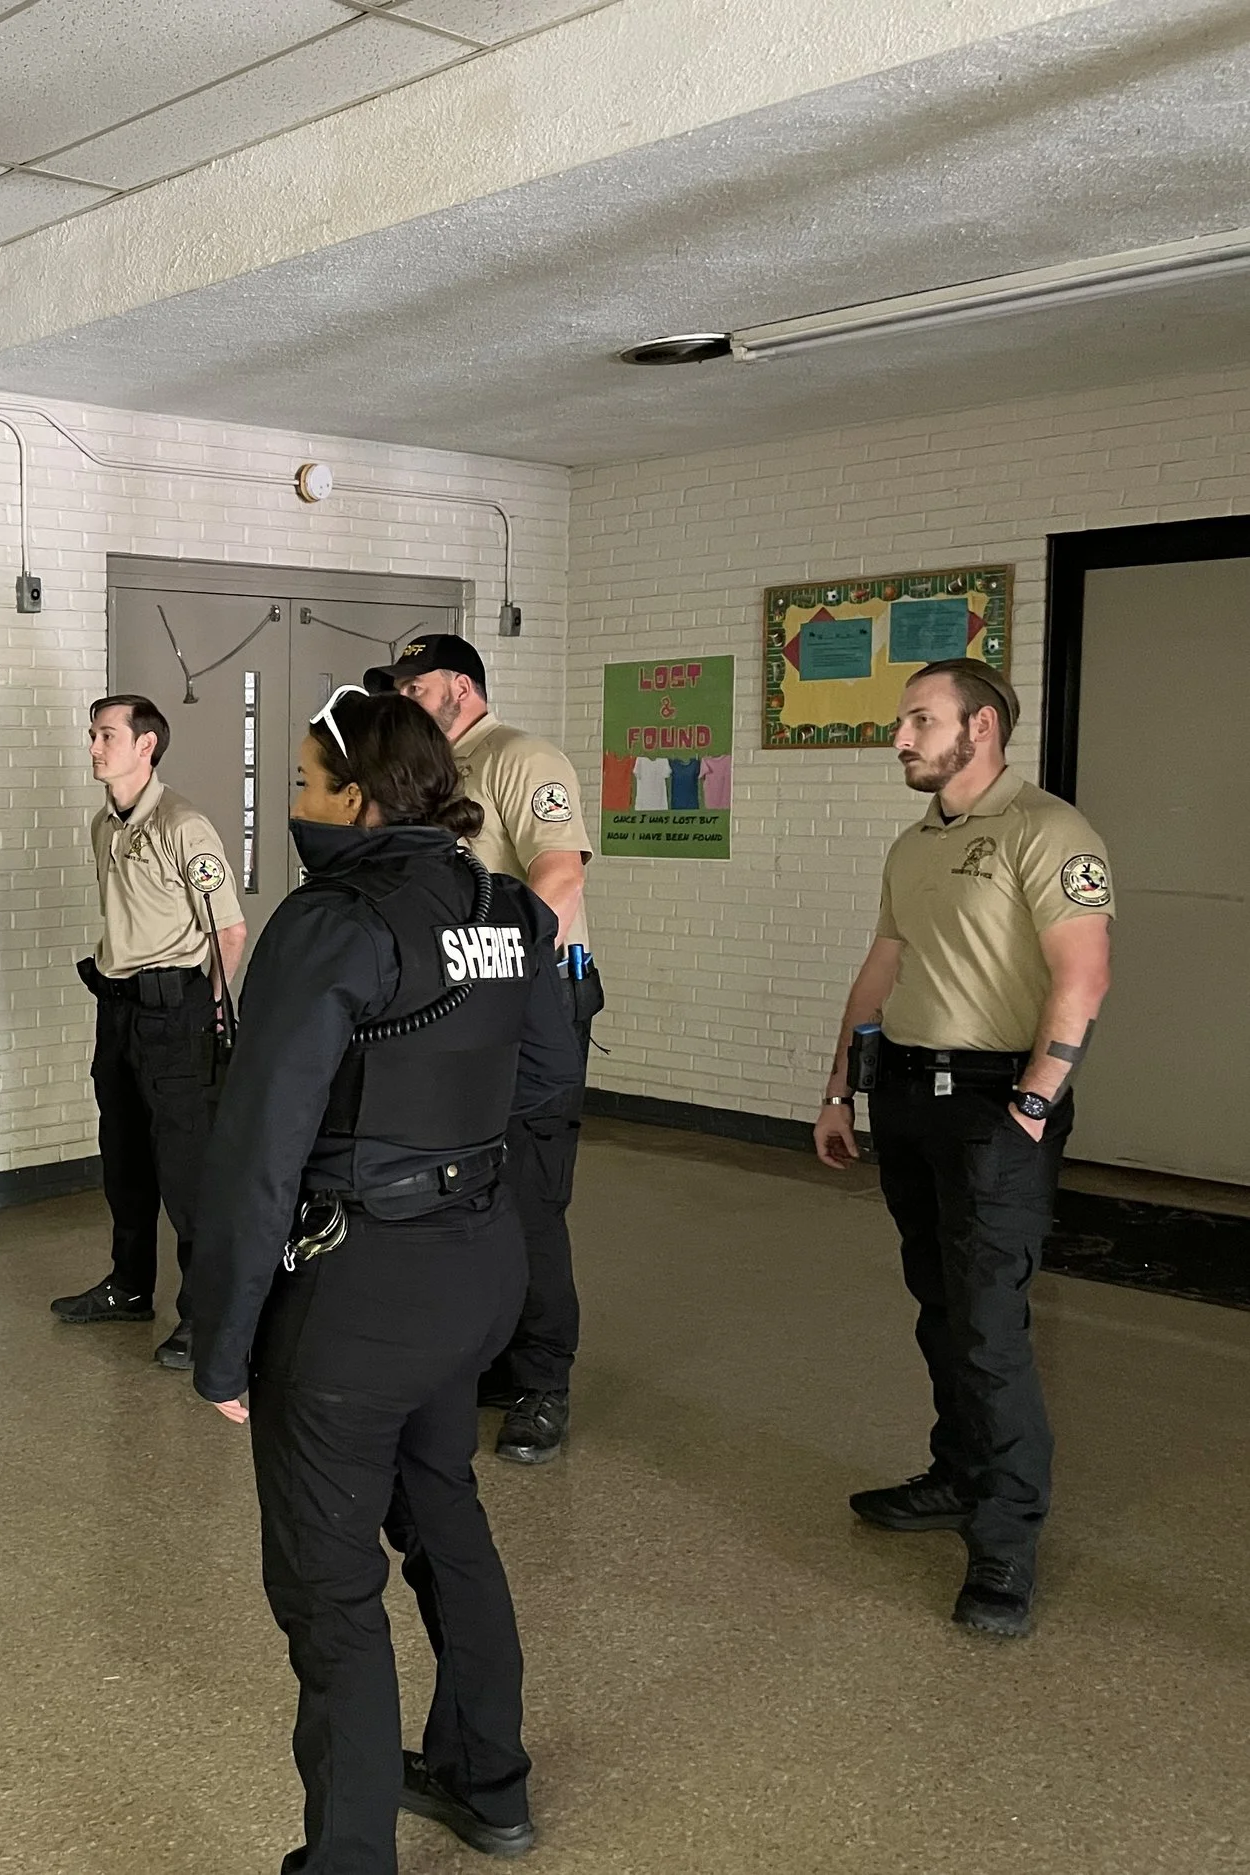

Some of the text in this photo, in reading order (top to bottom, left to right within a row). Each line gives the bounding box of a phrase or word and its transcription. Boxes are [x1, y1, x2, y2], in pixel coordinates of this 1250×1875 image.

[638, 663, 703, 691] LOST
[660, 695, 677, 719] &
[627, 724, 712, 751] FOUND
[613, 814, 719, 825] ONCE I WAS LOST BUT
[607, 832, 629, 840] NOW
[639, 832, 662, 841] HAVE
[666, 832, 689, 841] BEEN
[692, 833, 723, 842] FOUND
[441, 926, 525, 982] SHERIFF
